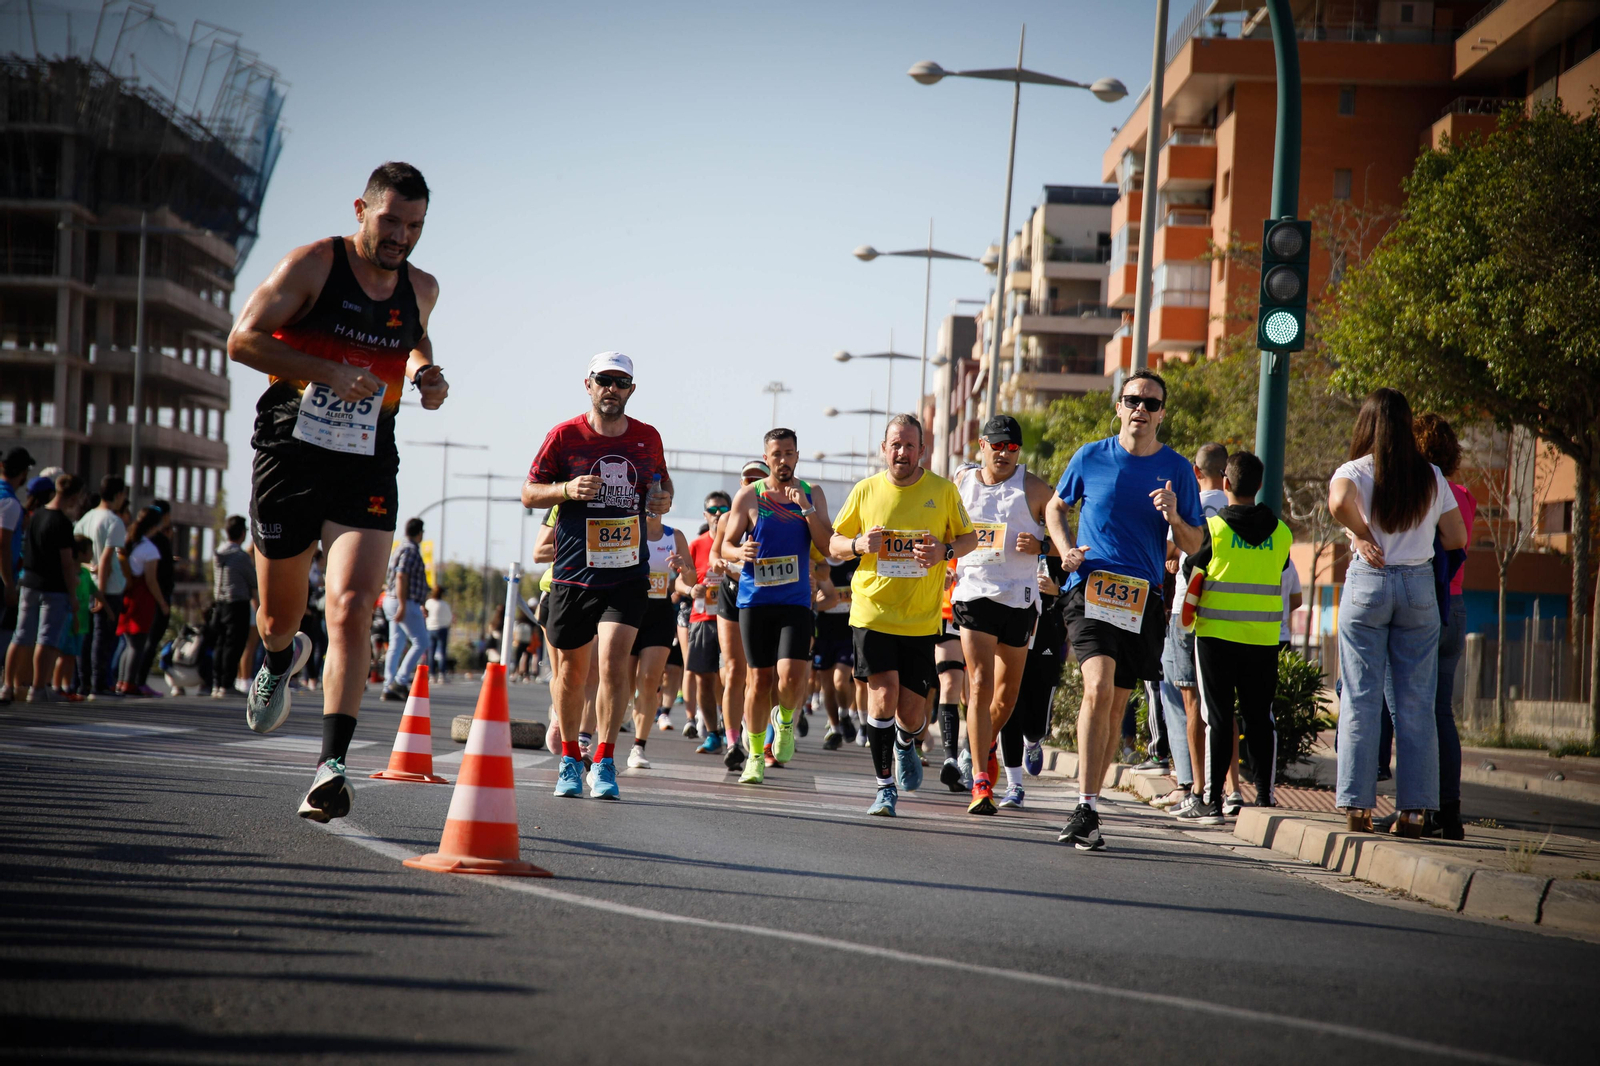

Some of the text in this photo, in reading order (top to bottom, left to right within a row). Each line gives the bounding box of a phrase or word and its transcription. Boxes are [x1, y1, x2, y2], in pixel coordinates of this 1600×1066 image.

[334, 323, 401, 349] HAMMAM
[310, 386, 375, 415] 5205
[325, 410, 353, 420] ALBERTO
[599, 526, 632, 542] 842
[1230, 532, 1274, 551] NA
[759, 562, 794, 578] 1110
[650, 577, 665, 590] 39
[1094, 580, 1140, 604] 1431
